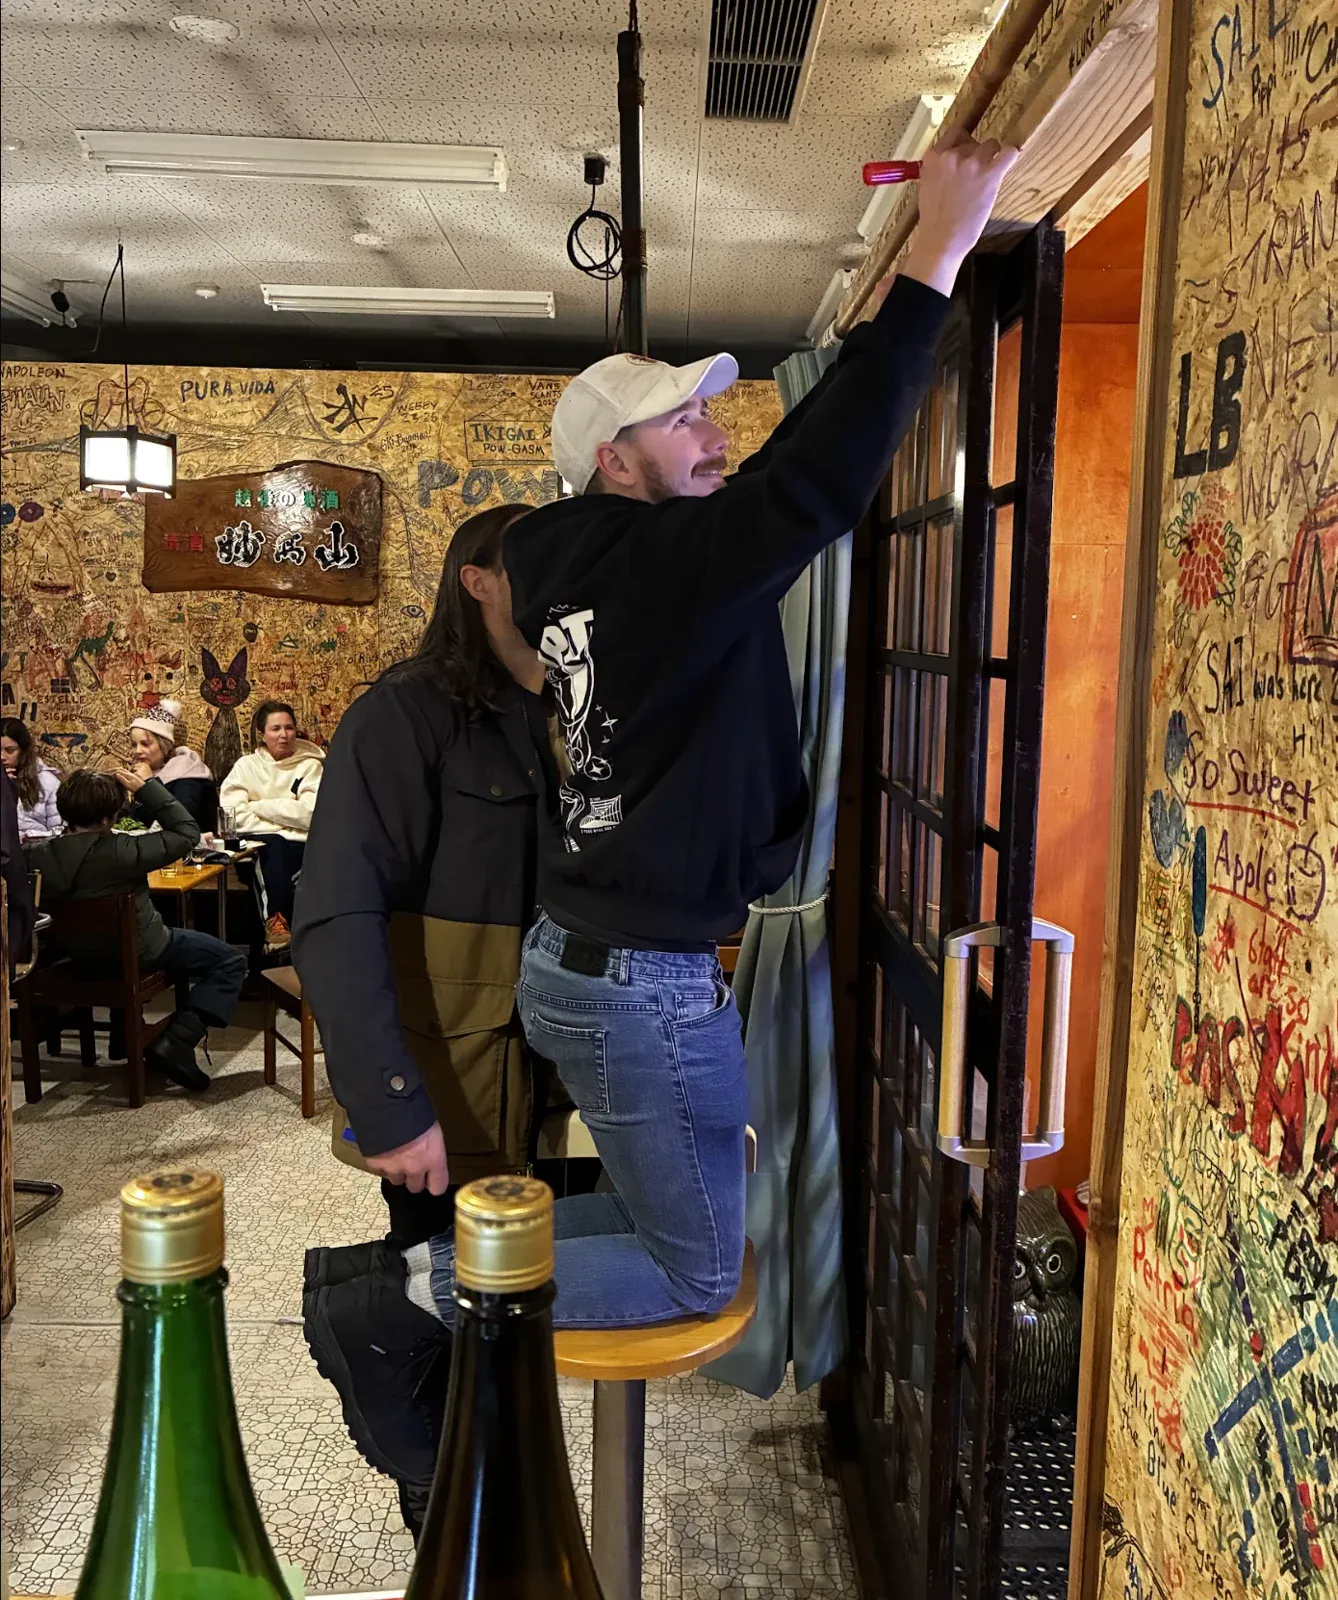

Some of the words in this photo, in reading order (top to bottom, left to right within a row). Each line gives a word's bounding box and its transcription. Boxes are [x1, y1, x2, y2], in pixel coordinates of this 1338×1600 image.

[180, 379, 233, 403] PURA
[240, 377, 275, 395] VIDA
[470, 423, 536, 442] IKIGAI
[483, 442, 545, 459] POW-GASM
[417, 459, 559, 509] POW
[1253, 667, 1285, 701] was
[1226, 748, 1316, 820] Sweet
[1213, 828, 1279, 912] Apple
